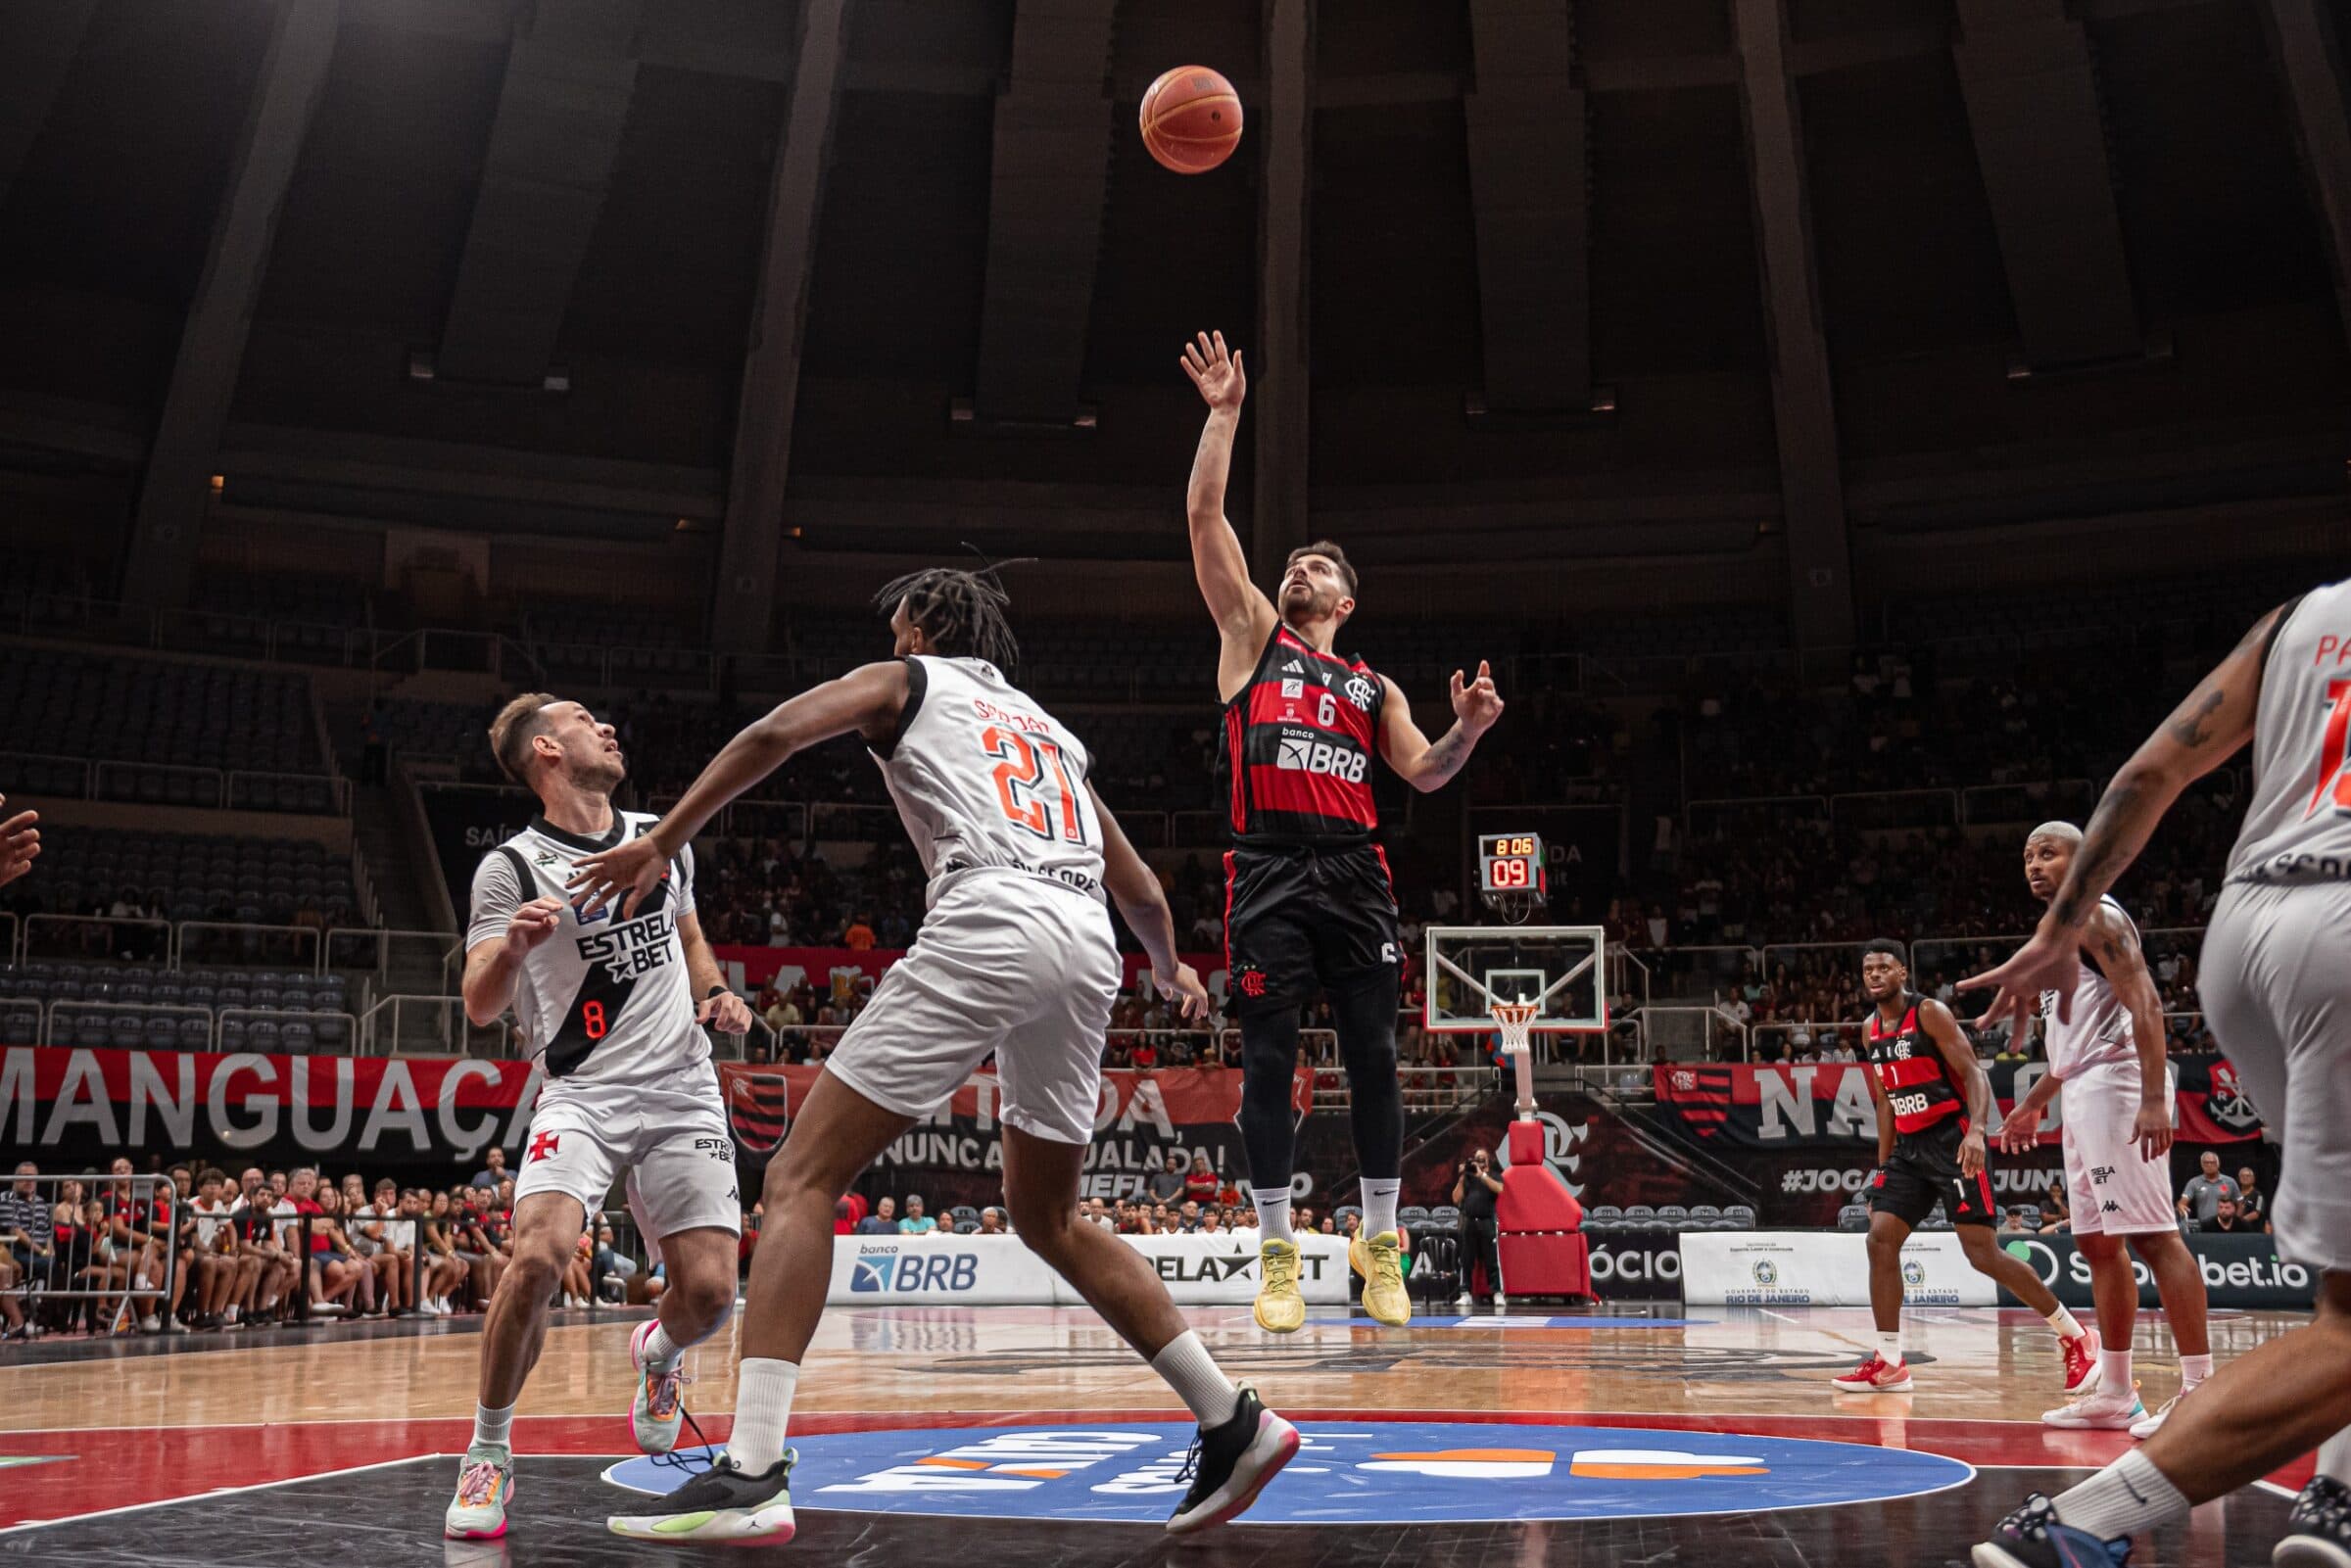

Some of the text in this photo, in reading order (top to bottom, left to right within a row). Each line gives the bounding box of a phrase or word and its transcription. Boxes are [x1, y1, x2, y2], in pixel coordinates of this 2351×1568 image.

[1319, 691, 1336, 727] 6
[1281, 727, 1315, 739] banco
[1309, 742, 1367, 784] BRB
[981, 725, 1083, 844] 21
[1494, 859, 1524, 886] 09
[632, 938, 673, 974] BET
[718, 959, 813, 1005] LA
[582, 1000, 606, 1038] 8
[1891, 1065, 1899, 1085] 1
[1895, 1093, 1929, 1117] BRB
[696, 1138, 730, 1150] ESTR
[860, 1244, 899, 1255] banco
[1589, 1242, 1680, 1279] ÓCIO
[895, 1253, 979, 1292] BRB
[1146, 1255, 1222, 1282] ELA
[1726, 1295, 1810, 1304] RIO DE JANEIRO
[1913, 1295, 1959, 1304] JANEIRO
